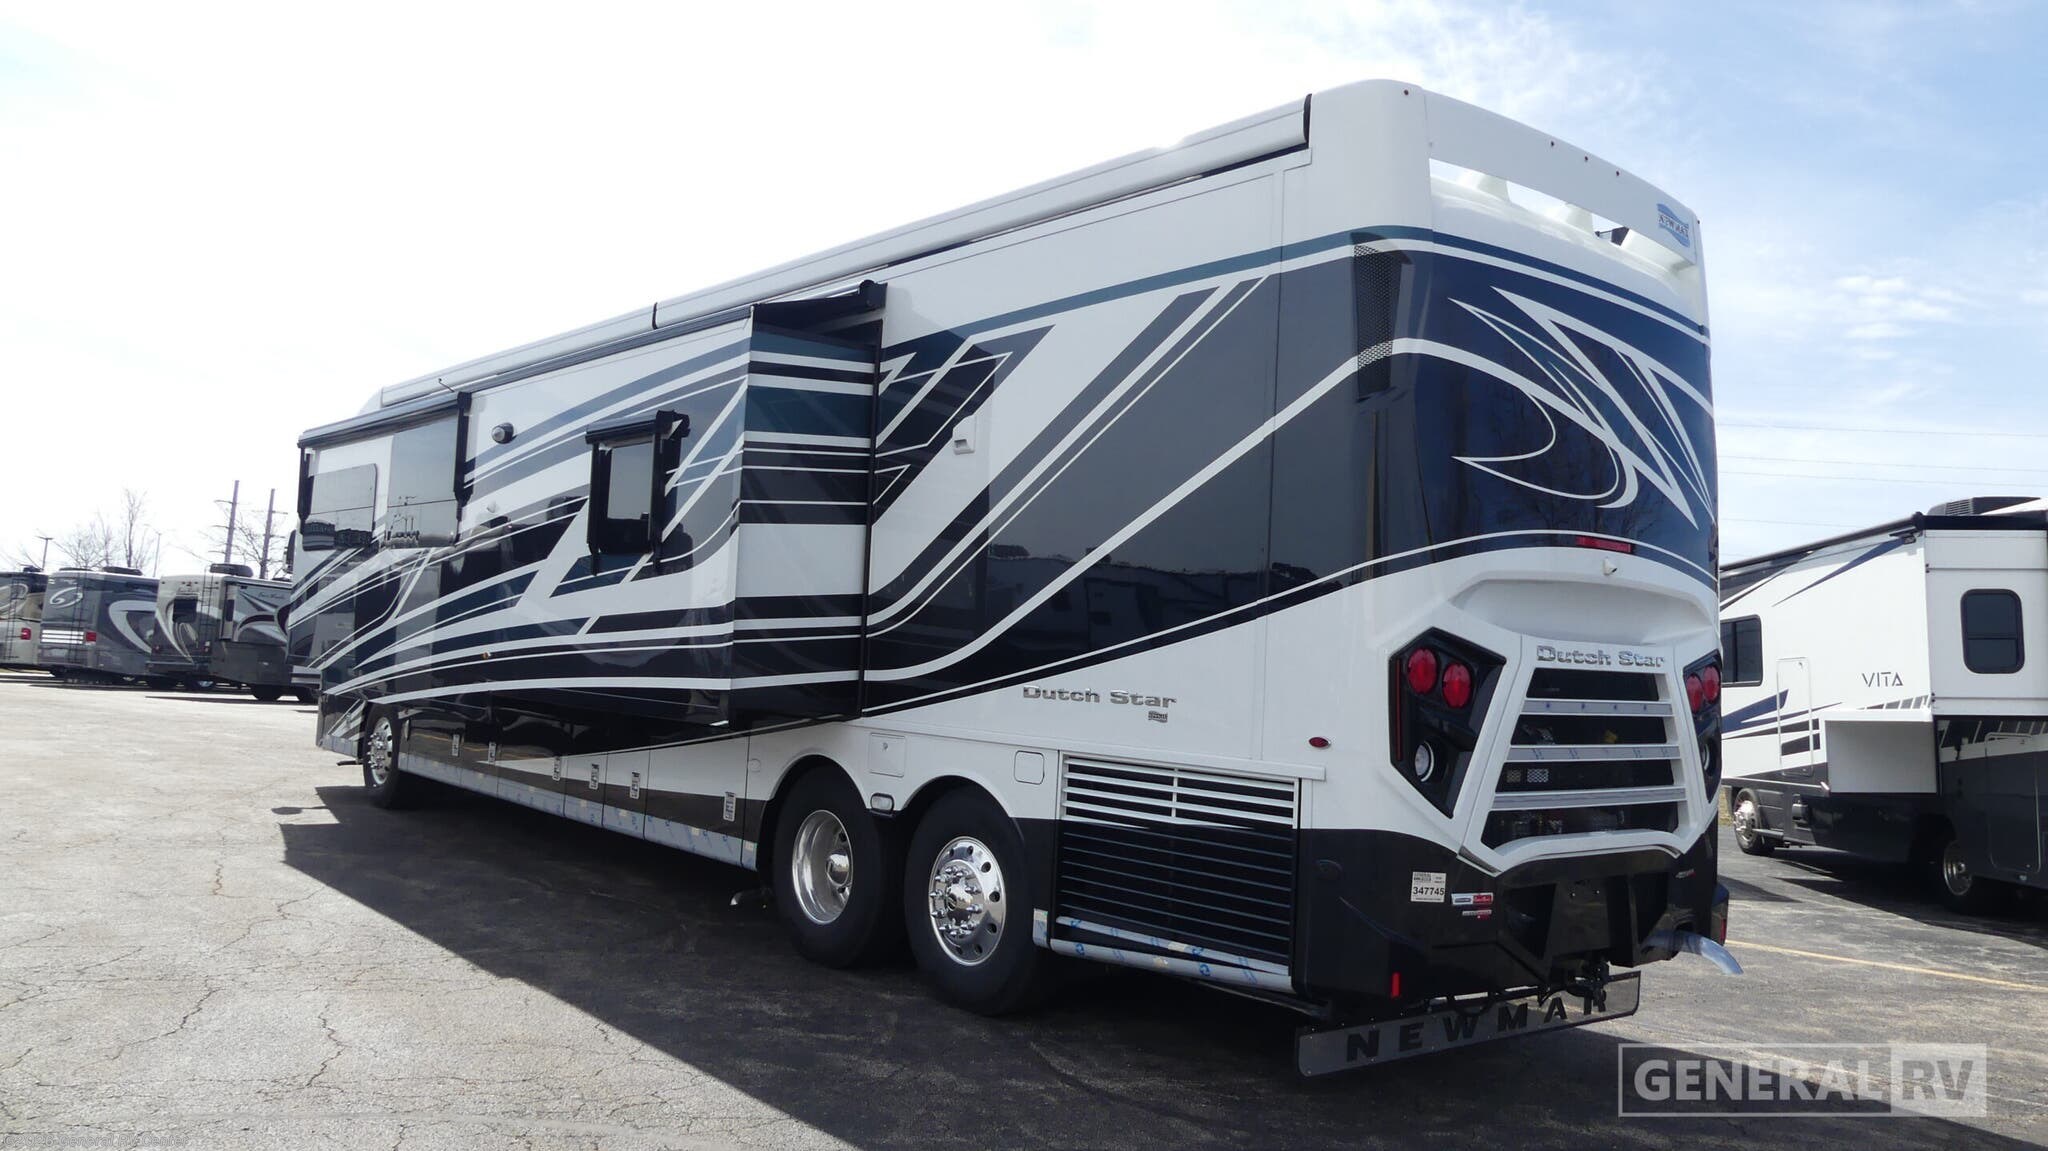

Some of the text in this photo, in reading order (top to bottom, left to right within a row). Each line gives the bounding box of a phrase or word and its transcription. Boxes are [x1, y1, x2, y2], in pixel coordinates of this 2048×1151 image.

[1536, 645, 1665, 667] Dutch Star
[1862, 671, 1904, 687] VITA
[1023, 685, 1177, 708] Dutch Star
[1412, 886, 1445, 896] 347745
